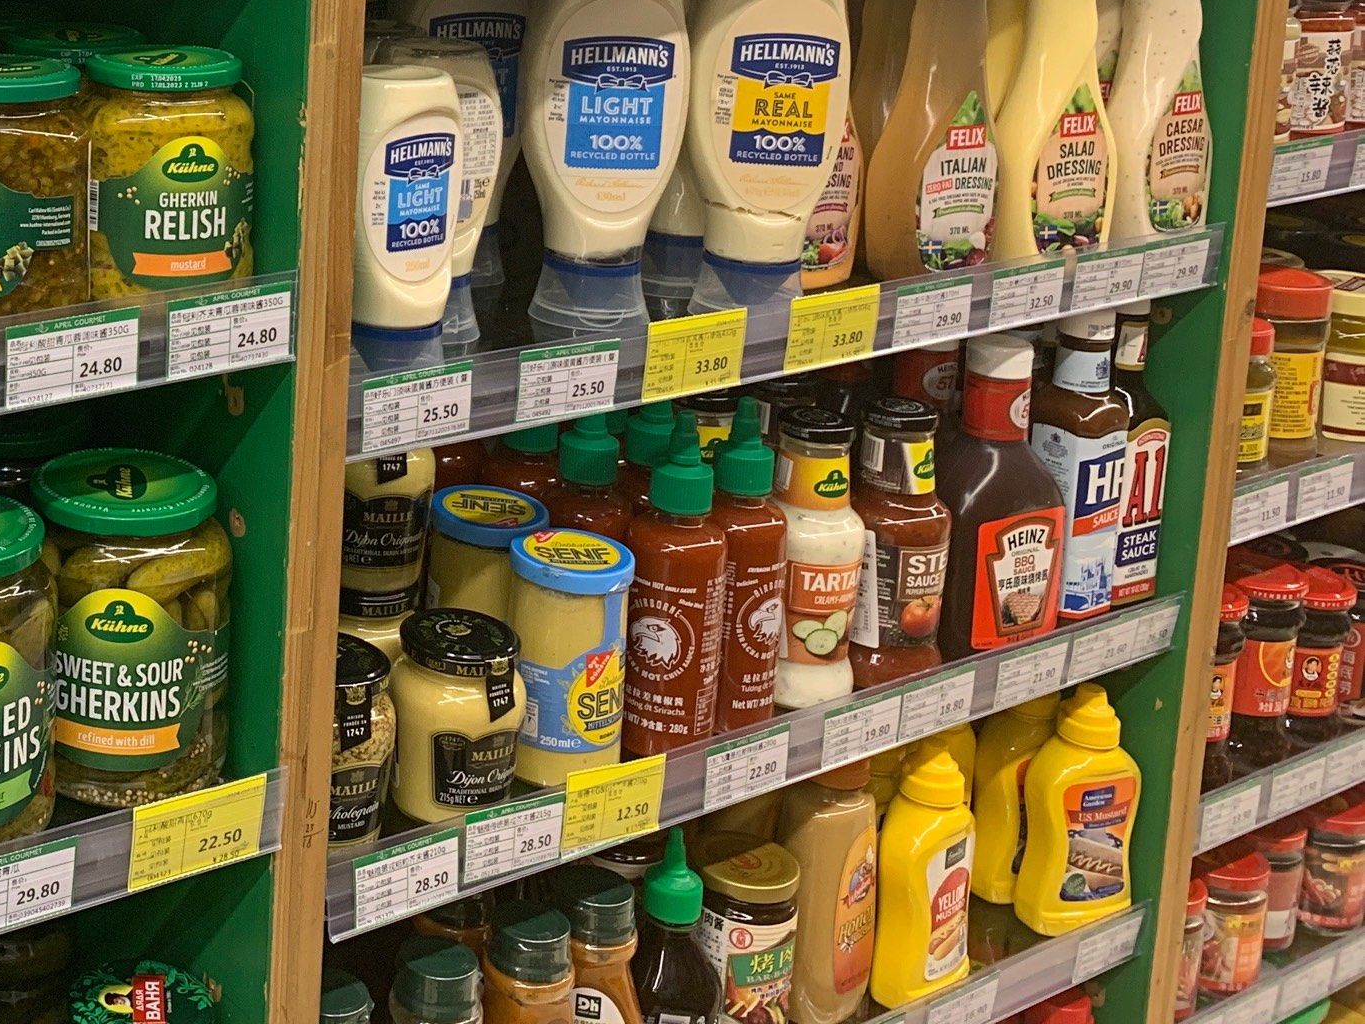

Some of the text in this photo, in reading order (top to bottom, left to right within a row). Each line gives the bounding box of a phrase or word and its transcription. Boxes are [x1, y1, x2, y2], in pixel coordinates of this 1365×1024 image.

[571, 43, 669, 68] HELLMANN'S
[740, 42, 835, 67] HELLMANN'S
[580, 95, 653, 115] LIGHT
[774, 91, 796, 100] SAME
[1174, 92, 1202, 114] FELIX
[754, 98, 813, 119] REAL
[579, 116, 652, 125] MAYONNAISE
[751, 118, 813, 129] MAYONNAISE
[1062, 114, 1096, 137] FELIX
[1166, 118, 1203, 137] CAESAR
[589, 134, 643, 151] 100%
[752, 134, 806, 152] 100%
[948, 128, 986, 149] FELIX
[1159, 136, 1206, 158] DRESSING
[390, 138, 453, 165] HELLMANN'S
[570, 150, 656, 161] RECYCLED BOTTLE
[736, 149, 819, 163] RECYCLED BOTTLE
[1059, 140, 1095, 160] SALAD
[167, 160, 215, 175] Kühne
[940, 157, 987, 176] ITALIAN
[1047, 158, 1102, 180] DRESSING
[954, 176, 993, 191] DRESSING
[159, 190, 218, 209] GHERKIN
[397, 186, 443, 209] LIGHT
[144, 207, 227, 241] RELISH
[399, 218, 439, 240] 100%
[170, 258, 206, 271] mustard
[237, 326, 277, 348] 24.80
[832, 329, 863, 350] 33.80
[80, 356, 122, 378] 24.80
[695, 355, 729, 375] 33.80
[571, 379, 605, 399] 25.50
[422, 402, 459, 424] 25.50
[383, 461, 401, 472] 1747
[1007, 528, 1045, 551] HEINZ
[1123, 530, 1157, 548] STEAK
[535, 545, 612, 561] SENF
[1014, 554, 1036, 569] BBQ
[1121, 543, 1156, 561] SAUCE
[1013, 564, 1036, 576] SAUCE
[906, 575, 941, 587] SAUCE
[90, 616, 149, 635] Kühne
[55, 649, 184, 689] SWEET & SOUR
[346, 726, 366, 738] 1747
[749, 761, 778, 780] 22.80
[616, 802, 649, 823] 12.50
[198, 827, 243, 853] 22.50
[520, 833, 552, 855] 28.50
[415, 871, 449, 894] 28.50
[16, 880, 60, 906] 29.80
